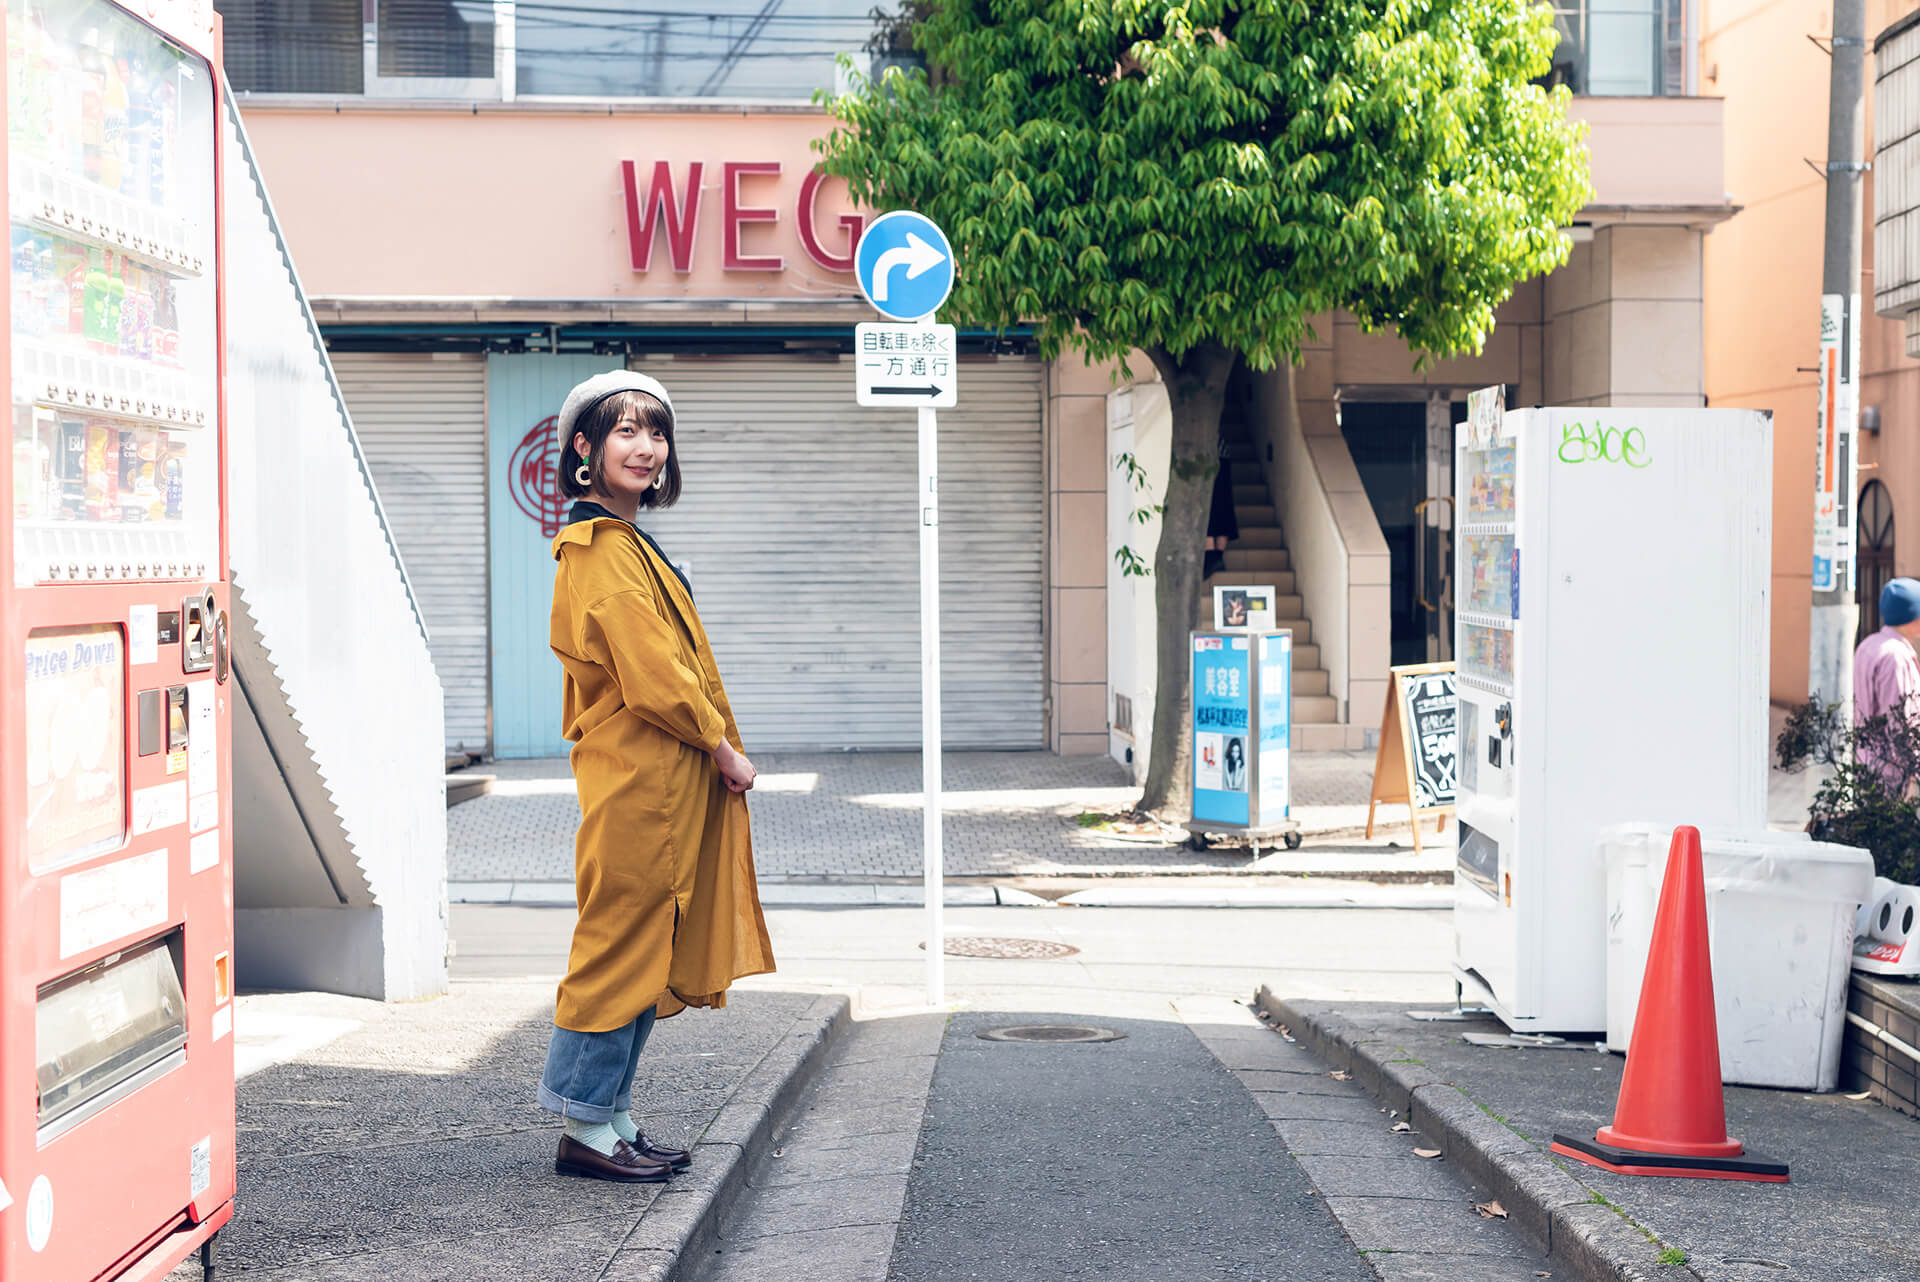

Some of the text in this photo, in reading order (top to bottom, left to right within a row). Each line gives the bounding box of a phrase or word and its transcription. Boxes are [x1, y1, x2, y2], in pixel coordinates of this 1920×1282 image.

[862, 332, 950, 352] 自転車を除く
[863, 356, 949, 377] 一方通行
[26, 642, 116, 677] Price Down
[1204, 666, 1241, 698] 美容室
